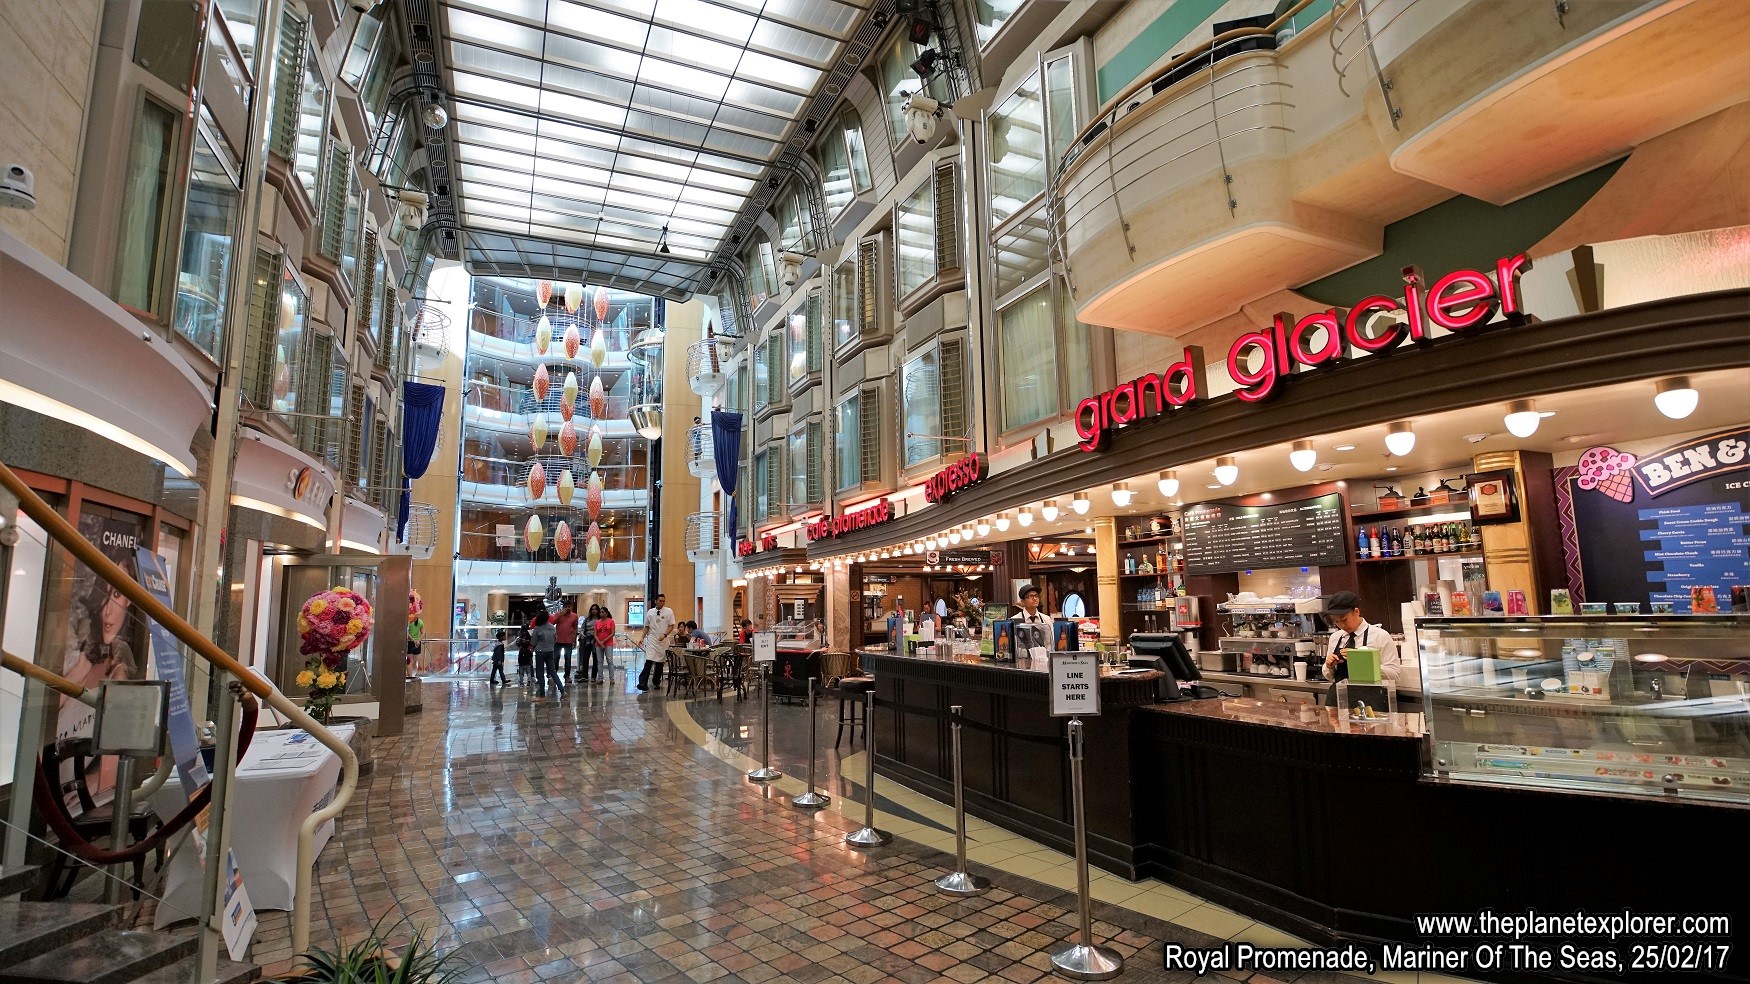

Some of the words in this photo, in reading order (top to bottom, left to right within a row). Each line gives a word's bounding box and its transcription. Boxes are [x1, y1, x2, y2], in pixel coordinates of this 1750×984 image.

[1075, 346, 1197, 452] grand
[1227, 253, 1529, 402] glacier
[925, 452, 980, 505] expresso
[1641, 444, 1717, 487] BEN
[1717, 439, 1747, 464] &
[103, 531, 137, 549] CHANEL
[832, 498, 889, 539] promenade
